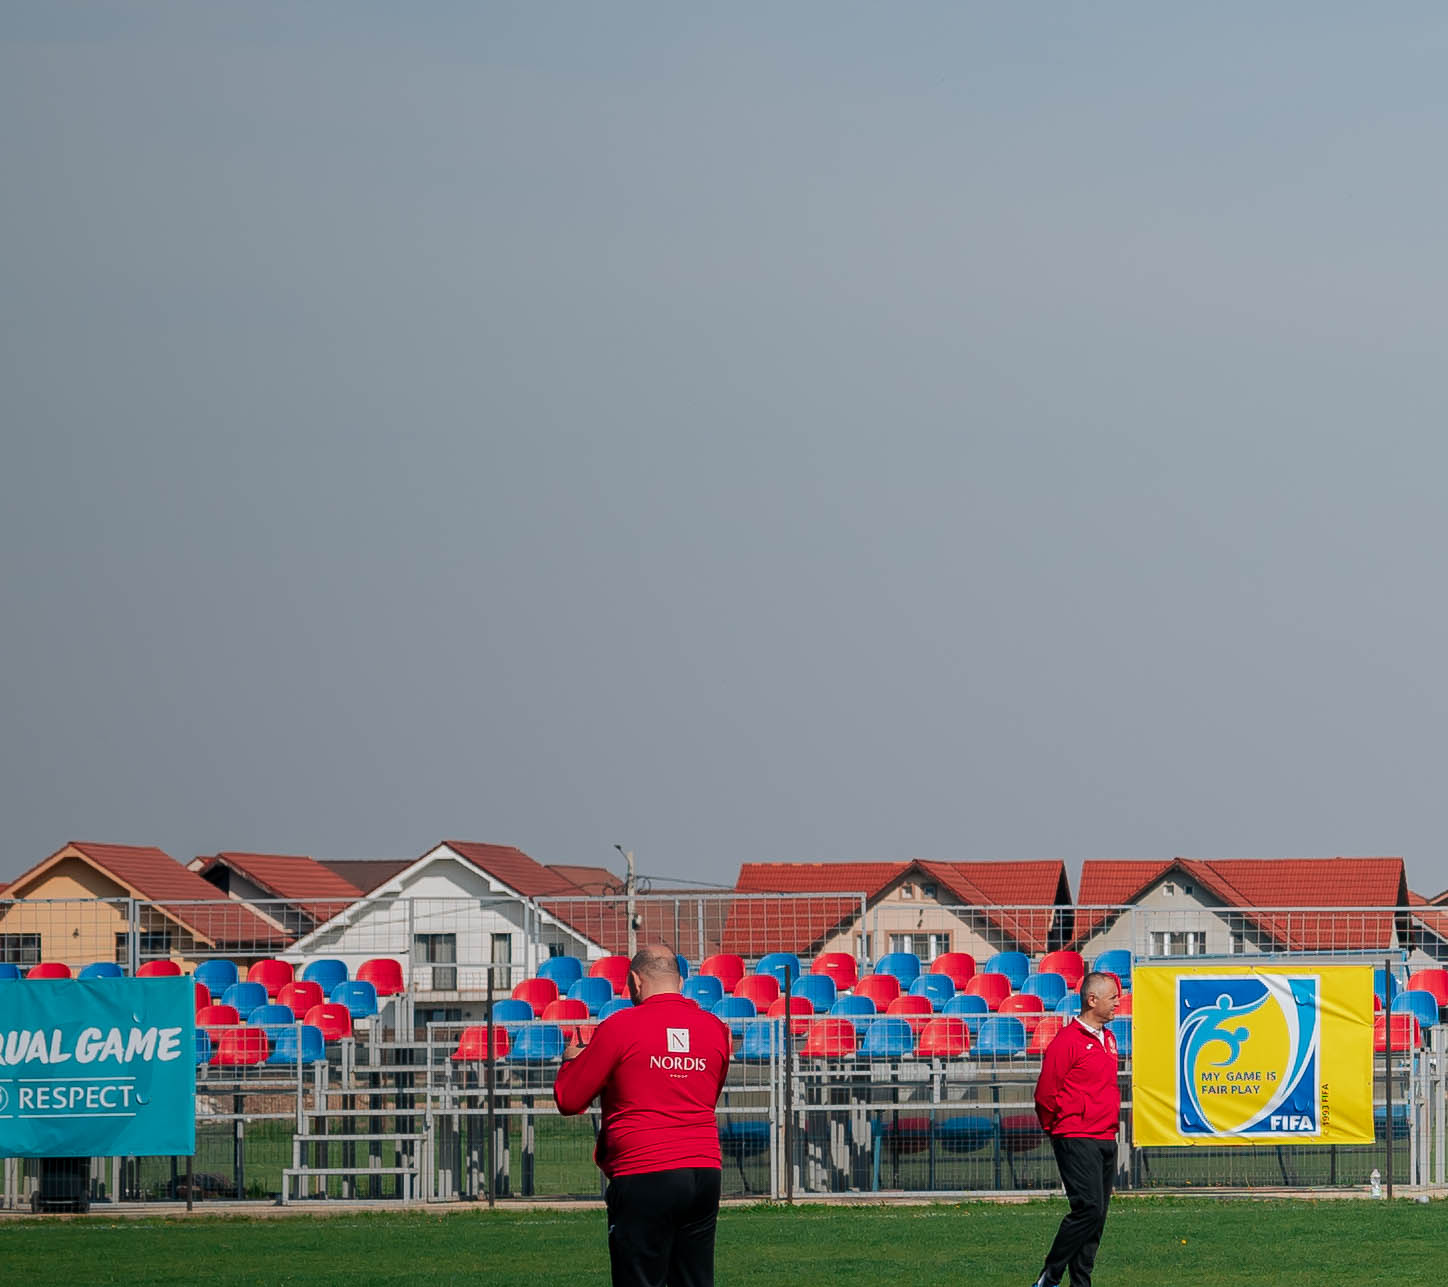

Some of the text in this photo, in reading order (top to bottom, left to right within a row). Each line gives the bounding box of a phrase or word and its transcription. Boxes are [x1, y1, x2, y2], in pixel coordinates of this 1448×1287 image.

[0, 1027, 182, 1065] UAL GAME
[649, 1055, 706, 1071] NORDIS
[1201, 1072, 1277, 1081] MY GAME IS
[19, 1085, 135, 1109] RESPECT
[1201, 1085, 1260, 1095] FAIR PLAY
[1321, 1083, 1329, 1103] FIFA
[1270, 1115, 1314, 1131] FIFA
